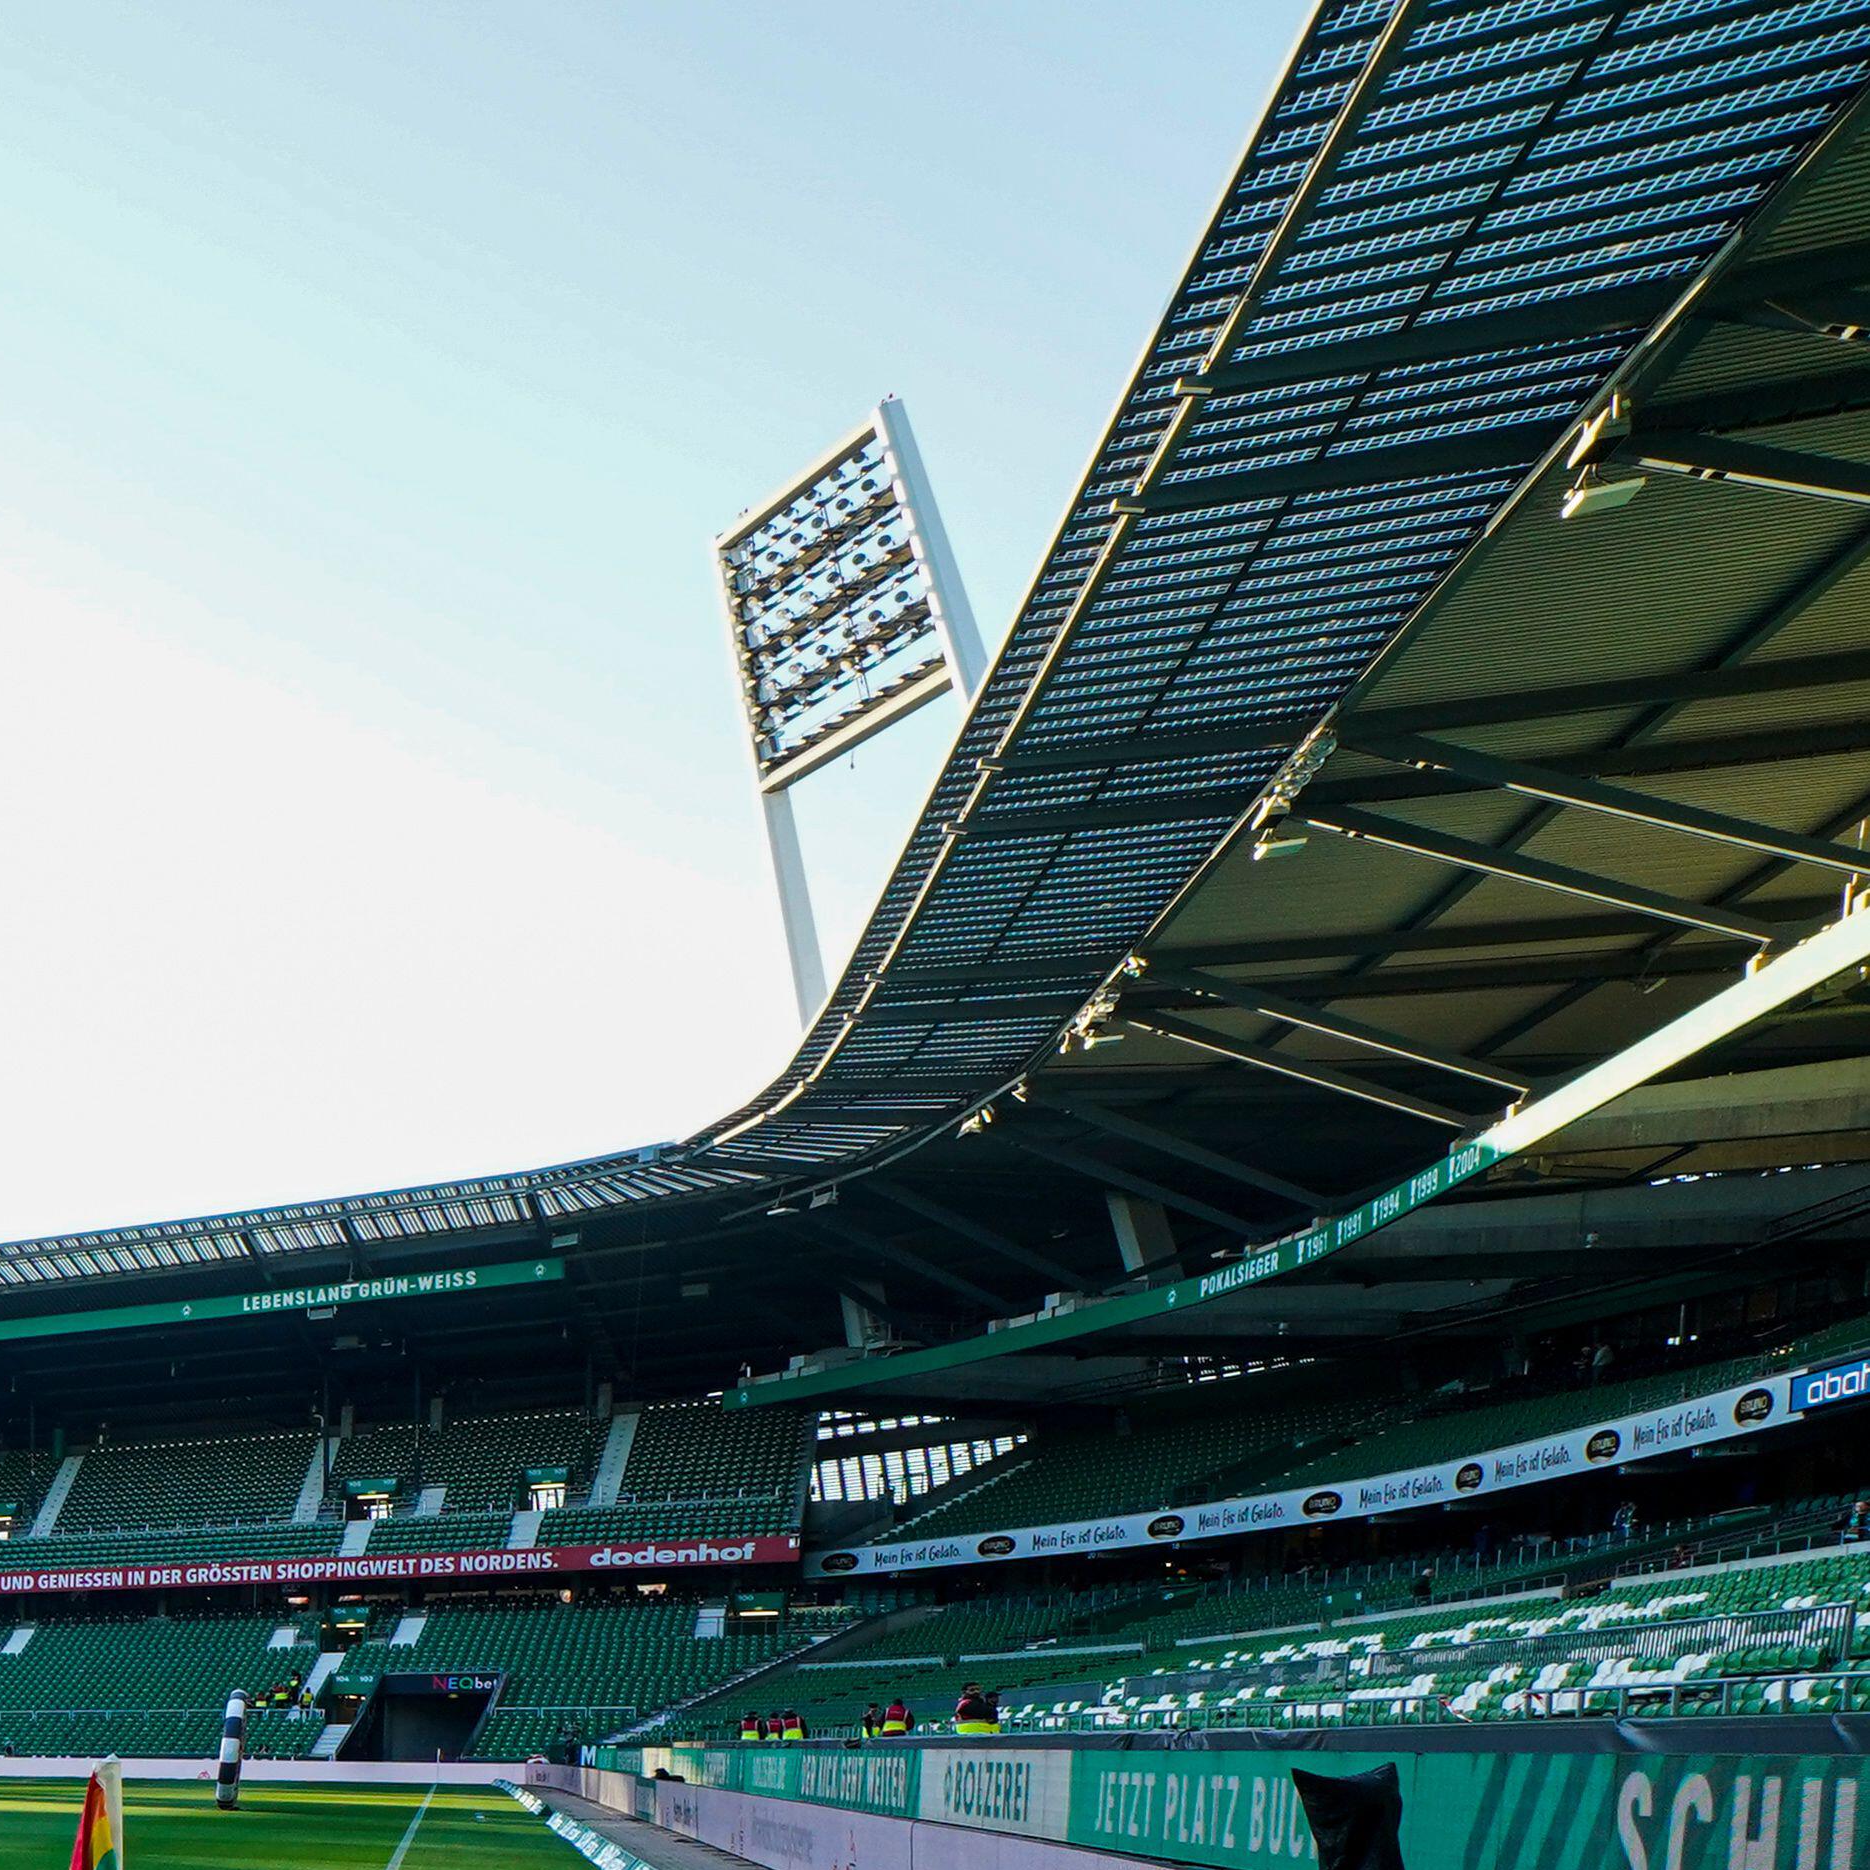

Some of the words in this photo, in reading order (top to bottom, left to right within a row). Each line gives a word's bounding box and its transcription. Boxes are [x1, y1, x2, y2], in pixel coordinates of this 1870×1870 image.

[1454, 1147, 1481, 1180] 2004
[1416, 1167, 1439, 1199] 1999
[1379, 1190, 1400, 1219] 1994
[1343, 1212, 1362, 1240] 1991
[1305, 1231, 1328, 1259] 1961
[1199, 1251, 1280, 1298] POKALSIEGER
[242, 1285, 352, 1312] LEBENSLANG
[359, 1269, 478, 1298] GRÜN-WEISS
[1634, 1425, 1655, 1450] Mein
[1495, 1458, 1515, 1482] Mein
[1360, 1486, 1382, 1509] Mein
[1412, 1475, 1444, 1498] Gelato.
[1198, 1511, 1220, 1532] Mein
[1250, 1502, 1286, 1522] Gelato.
[1032, 1534, 1057, 1551] Mein
[1060, 1531, 1076, 1548] Eis
[1077, 1529, 1091, 1545] ist
[1093, 1525, 1128, 1544] Gelato.
[589, 1541, 755, 1568] dodenhof
[874, 1551, 898, 1568] Mein
[900, 1549, 914, 1565] Eis
[929, 1543, 962, 1561] Gelato.
[1, 1574, 35, 1591] UND
[38, 1570, 124, 1589] GENIESSEN
[127, 1570, 145, 1587] IN
[149, 1567, 183, 1587] DER
[186, 1562, 273, 1585] GRÖSSTEN
[277, 1556, 417, 1582] SHOPPINGWELT
[420, 1554, 456, 1575] DES
[459, 1550, 559, 1573] NORDENS.
[952, 1760, 1030, 1823] BOLZEREI
[1095, 1770, 1157, 1839] JETZT
[1163, 1773, 1242, 1850] PLATZ
[1248, 1775, 1318, 1861] BUC
